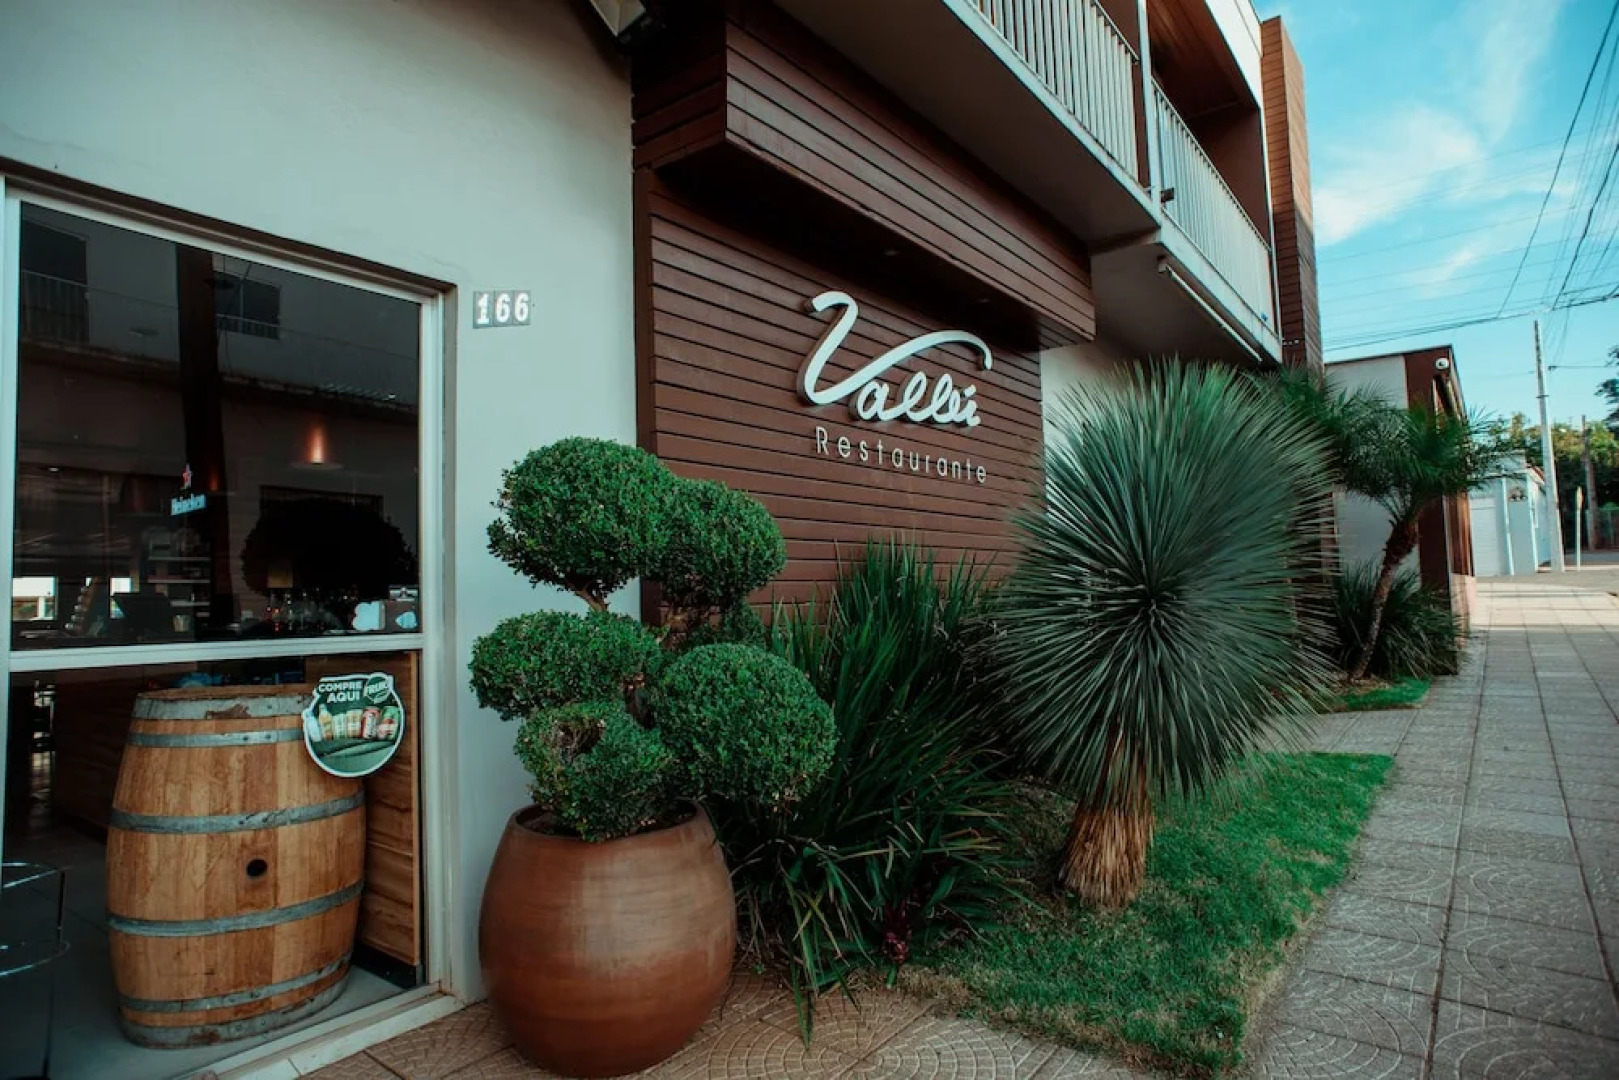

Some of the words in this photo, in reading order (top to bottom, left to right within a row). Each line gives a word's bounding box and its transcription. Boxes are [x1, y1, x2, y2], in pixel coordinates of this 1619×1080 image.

[475, 292, 530, 326] 166
[814, 425, 988, 484] Restaurante
[318, 680, 363, 692] COMPRE
[327, 691, 360, 704] AQUI
